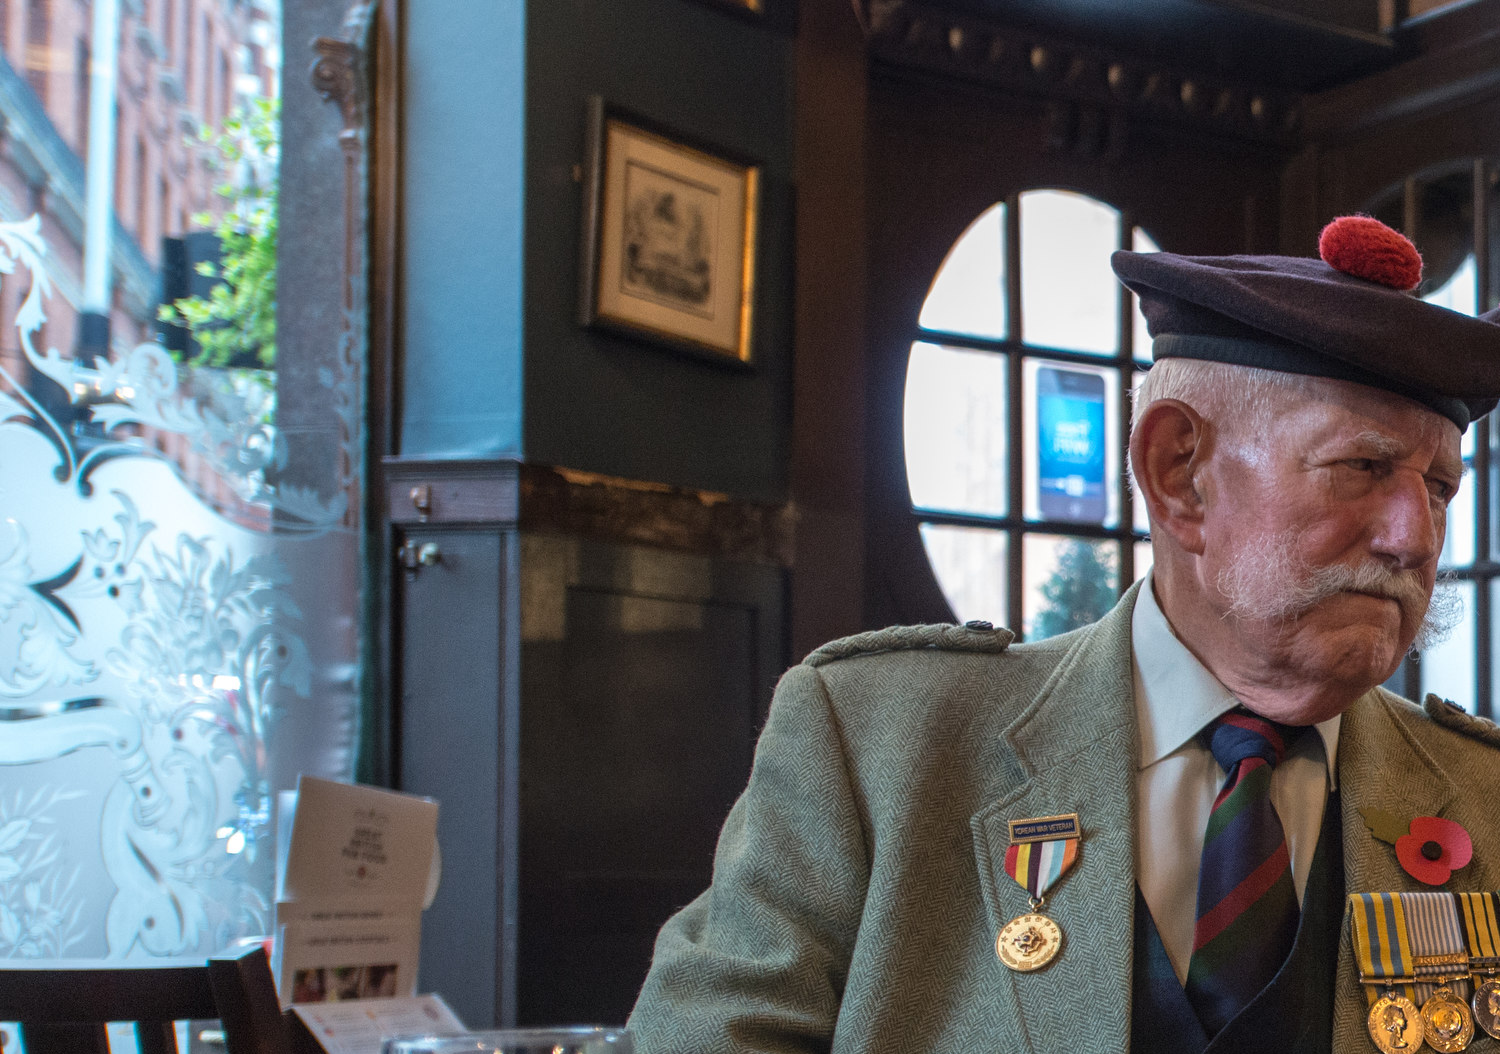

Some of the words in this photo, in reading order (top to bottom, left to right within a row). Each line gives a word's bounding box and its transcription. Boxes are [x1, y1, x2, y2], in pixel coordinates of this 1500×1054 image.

[1015, 826, 1037, 836] KOREAN
[1036, 824, 1049, 834] WAR
[1048, 821, 1074, 832] VETERAN
